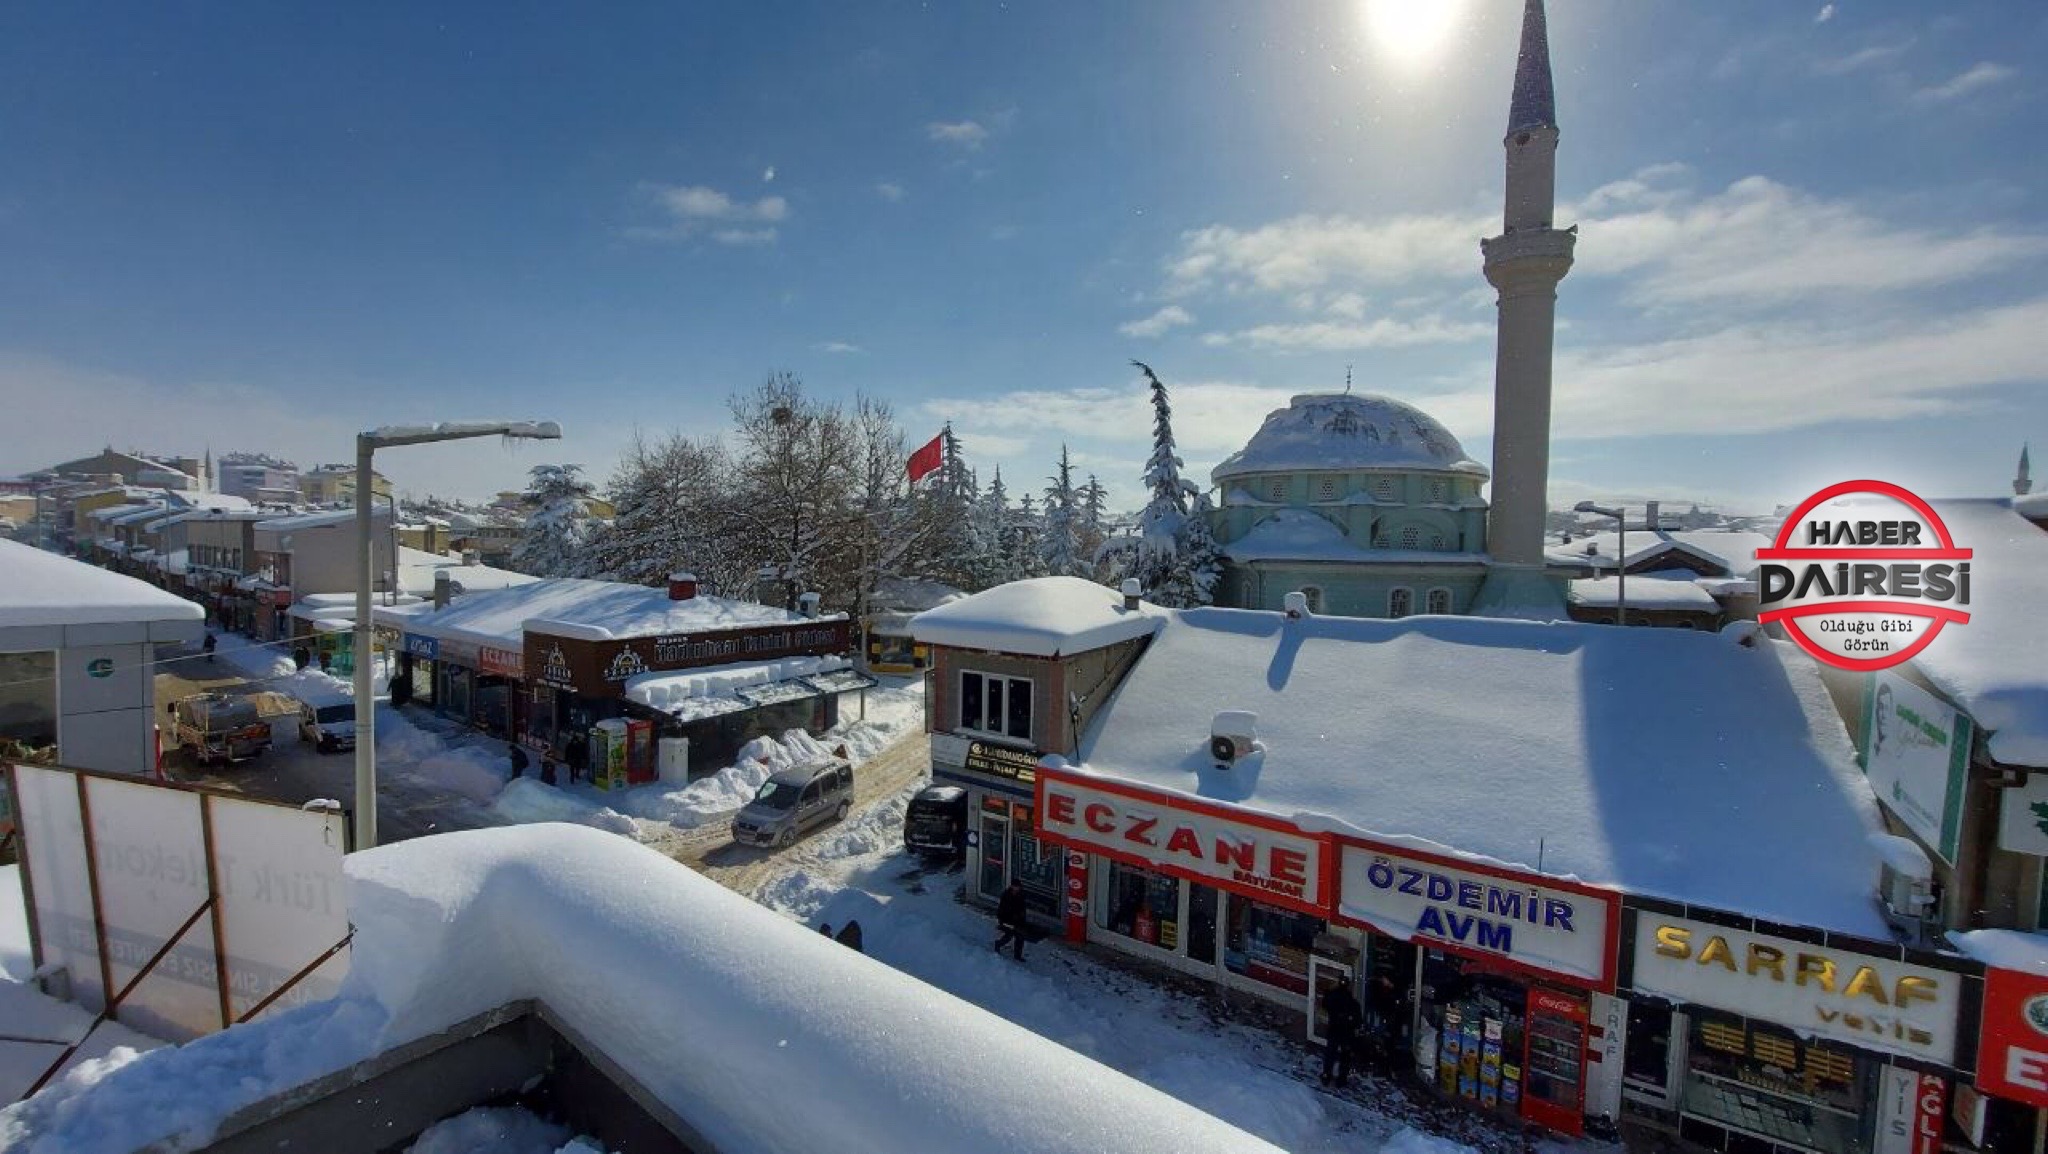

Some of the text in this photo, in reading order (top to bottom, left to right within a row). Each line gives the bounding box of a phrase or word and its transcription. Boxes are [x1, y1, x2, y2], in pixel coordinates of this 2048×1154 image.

[1048, 792, 1308, 887] ECZANE
[1366, 856, 1576, 932] ÖZDEMİR
[1416, 906, 1513, 953] AVM
[1655, 923, 1940, 1010] SARRAF
